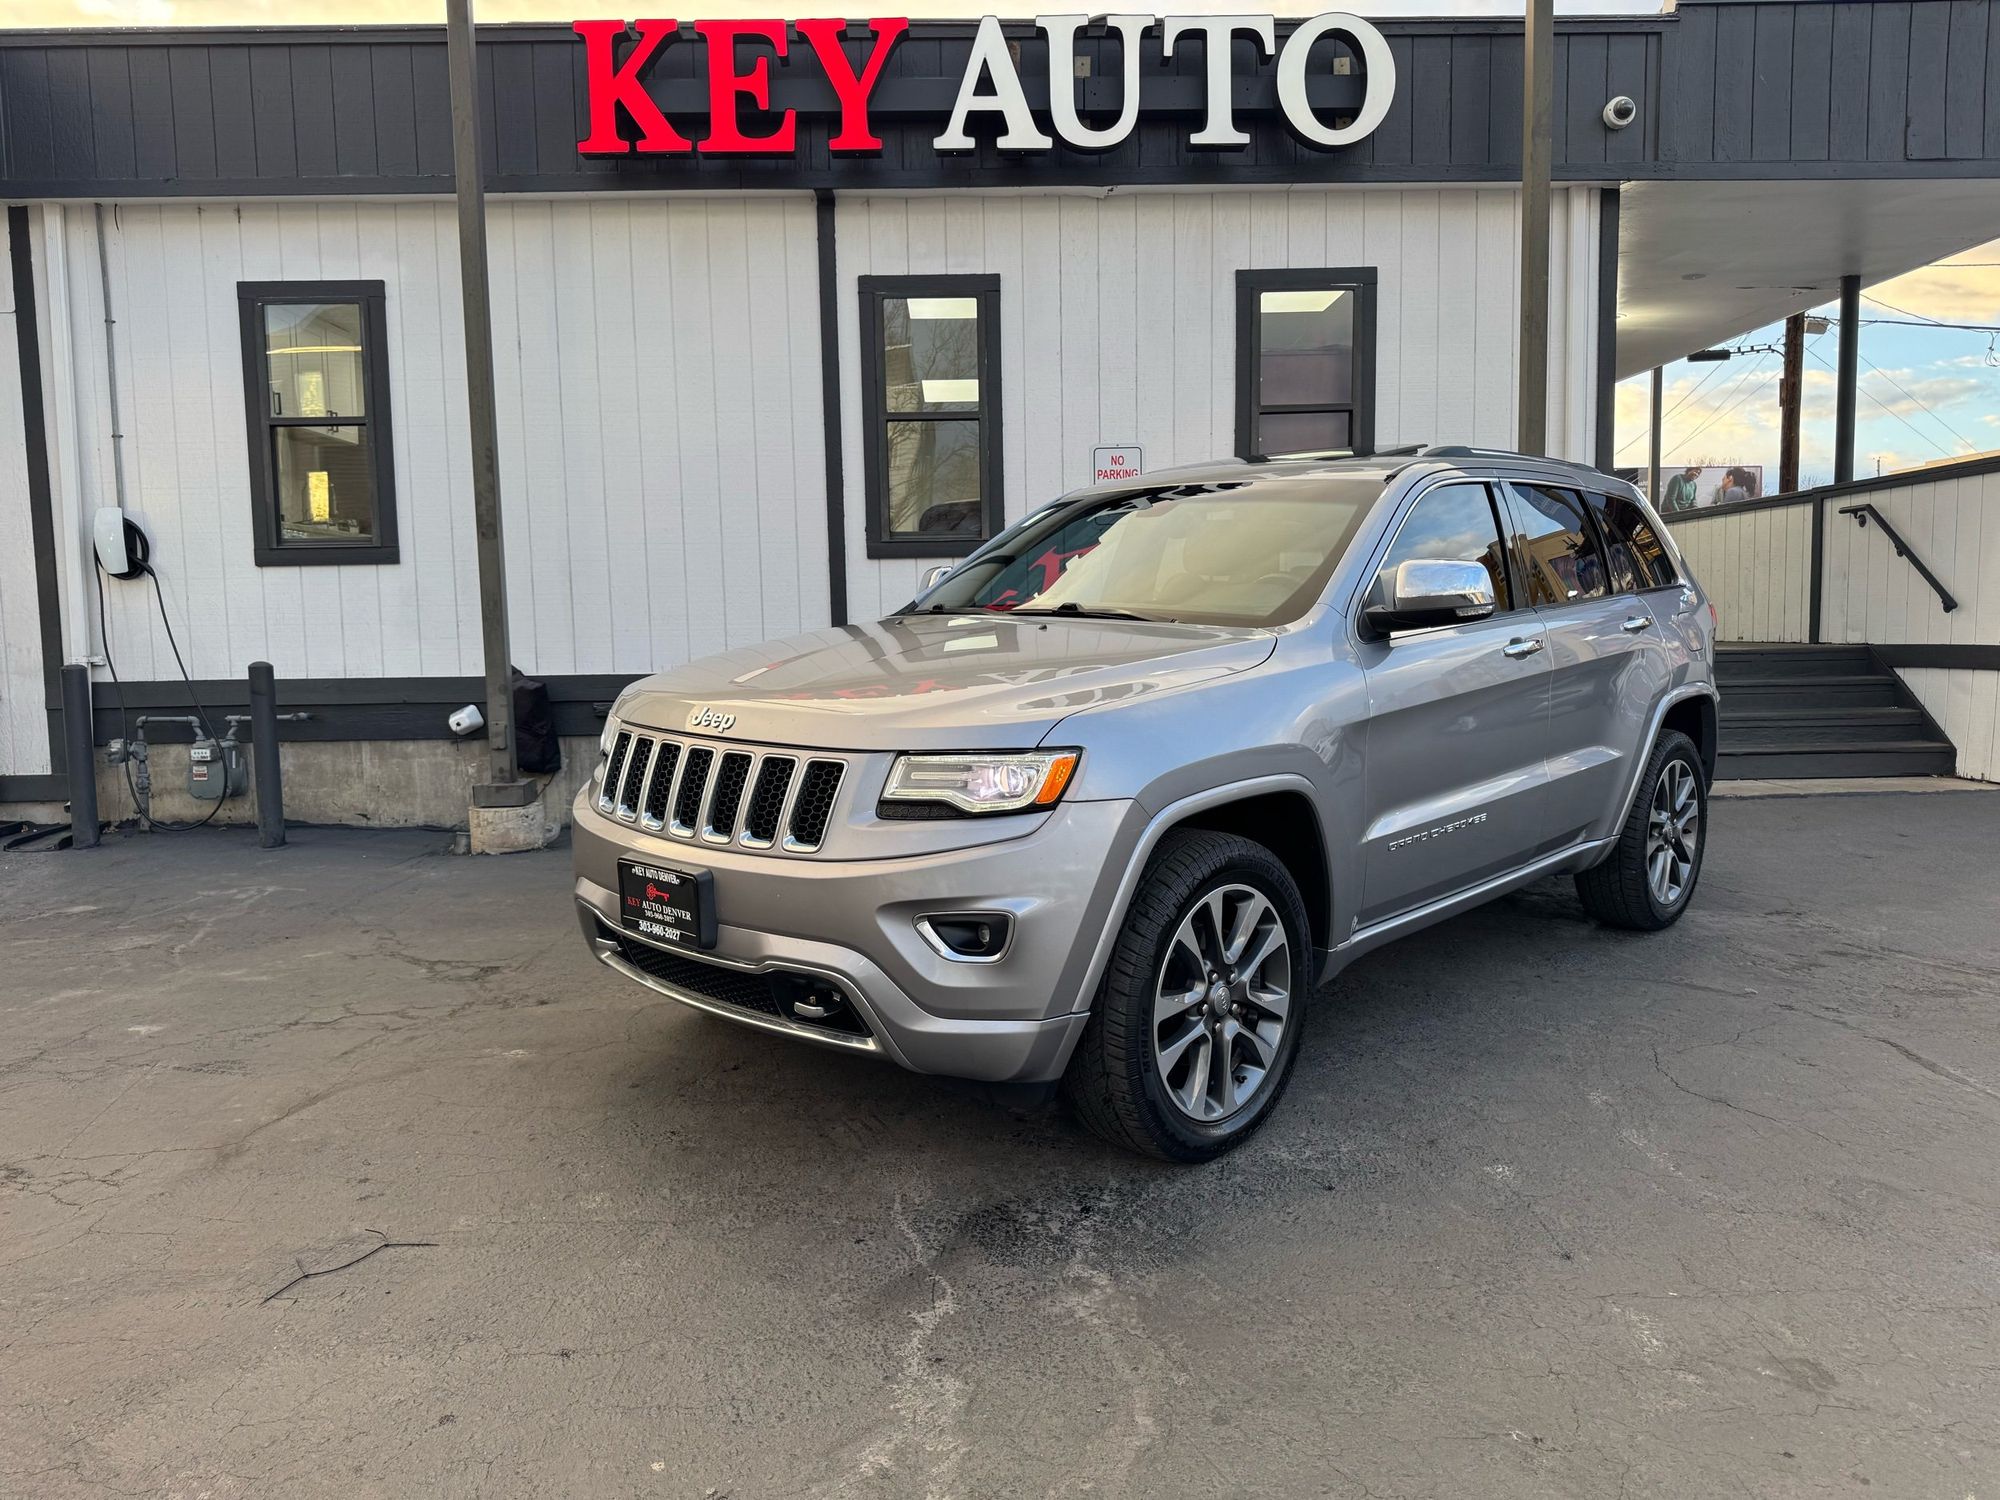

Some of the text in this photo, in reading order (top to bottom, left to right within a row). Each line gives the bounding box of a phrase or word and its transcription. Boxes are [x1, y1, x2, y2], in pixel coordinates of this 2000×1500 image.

[572, 12, 1396, 153] KEY AUTO
[1110, 455, 1125, 466] NO
[1097, 468, 1139, 480] PARKING
[691, 706, 736, 733] Jeep
[635, 865, 677, 884] KEY AUTO DENVER
[626, 896, 692, 921] KEY AUTO DENVER
[638, 919, 681, 941] 303-960-2027
